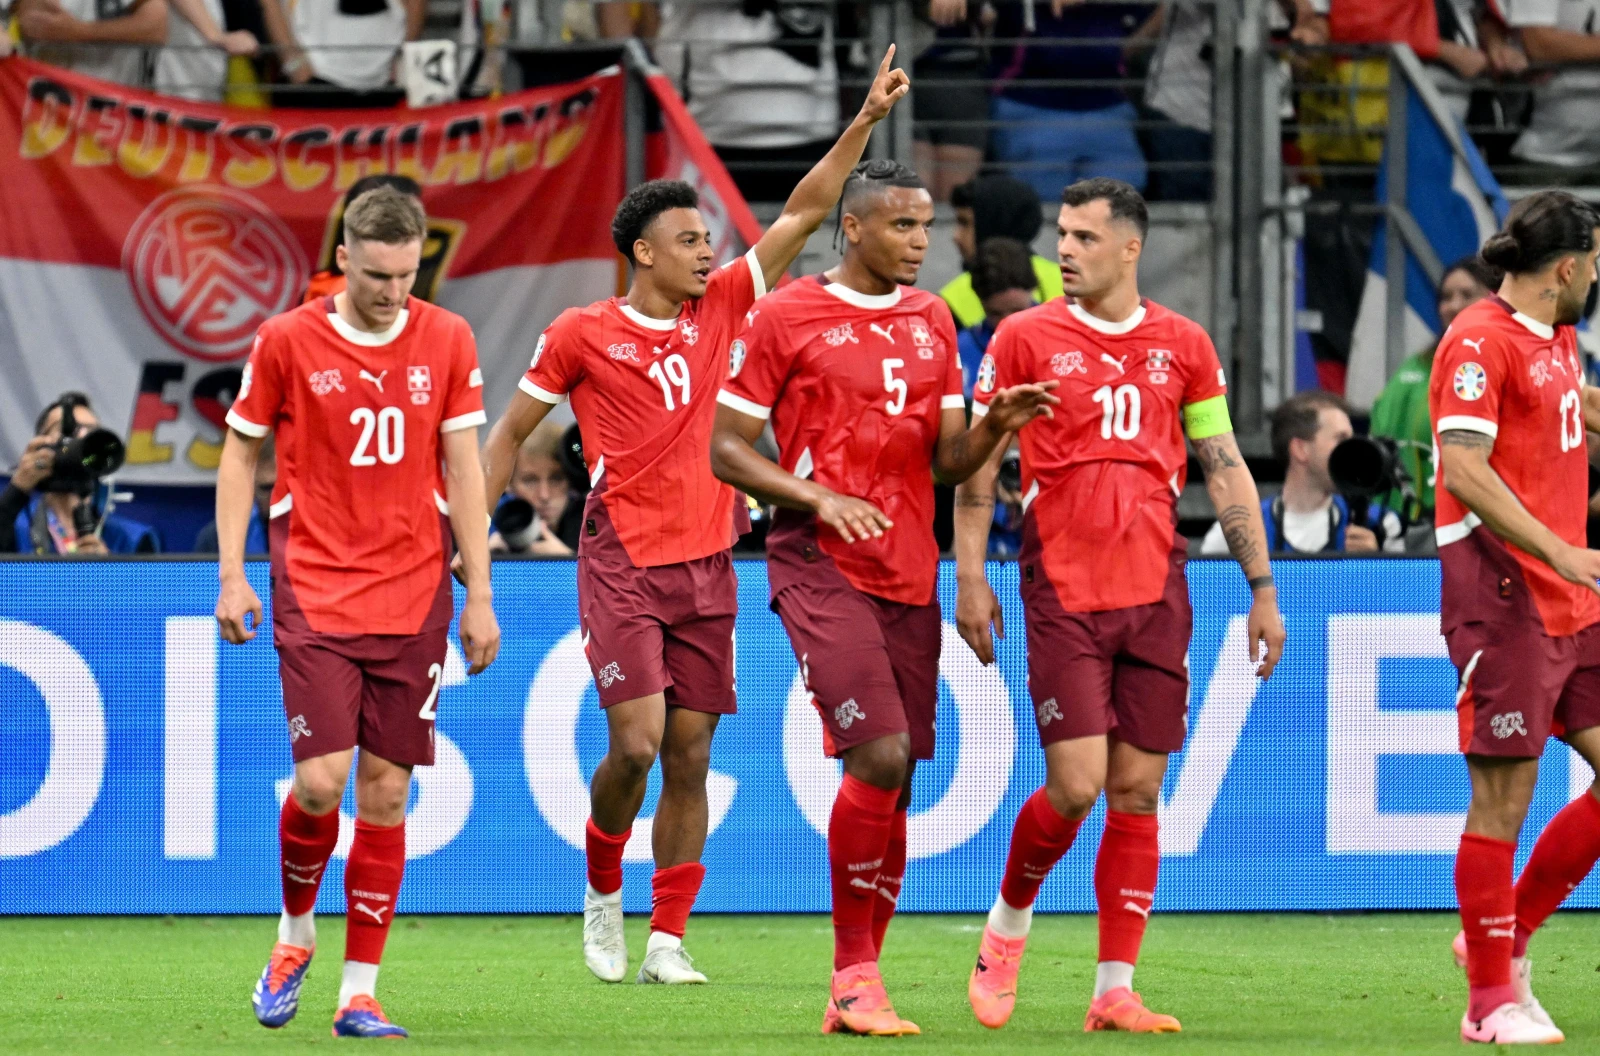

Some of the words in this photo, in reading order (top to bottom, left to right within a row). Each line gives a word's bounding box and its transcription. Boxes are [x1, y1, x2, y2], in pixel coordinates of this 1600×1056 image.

[20, 77, 598, 191] DEUTSCHLAND
[648, 353, 690, 411] 19
[882, 358, 908, 416] 5
[350, 407, 405, 467] 20
[1092, 383, 1141, 441] 10
[1559, 388, 1583, 453] 13
